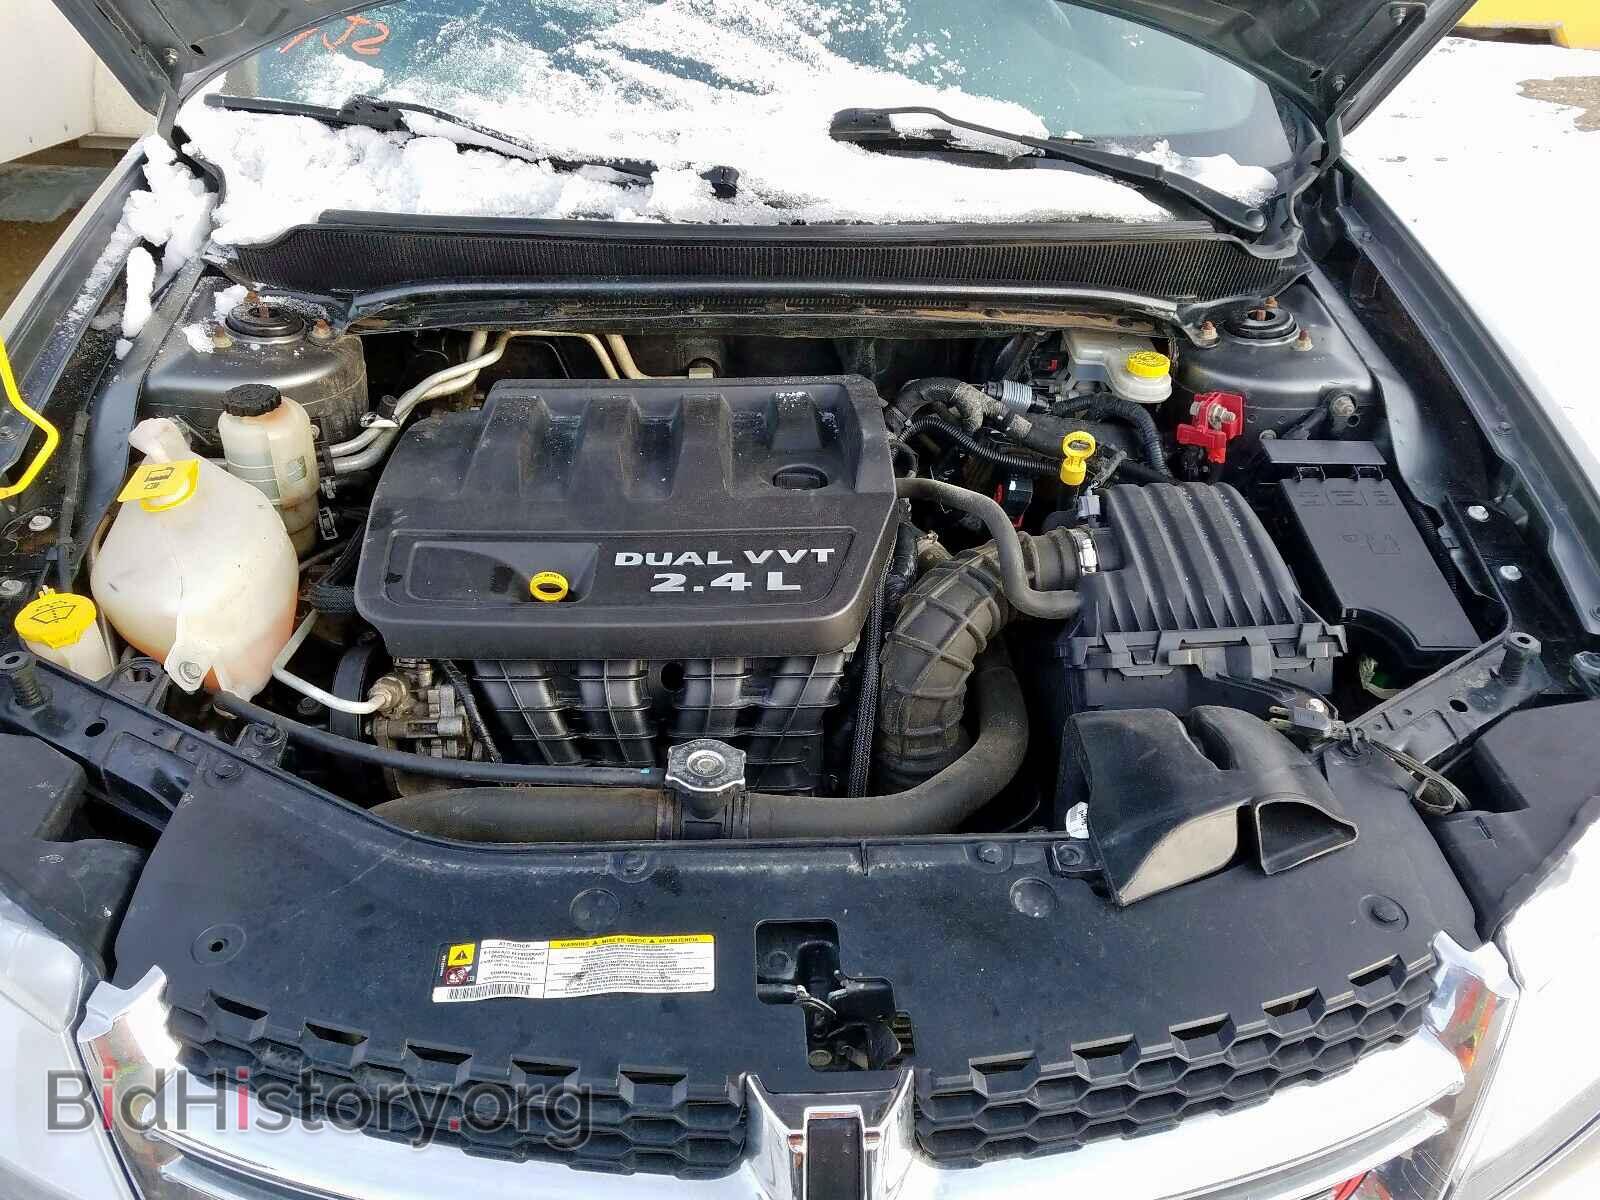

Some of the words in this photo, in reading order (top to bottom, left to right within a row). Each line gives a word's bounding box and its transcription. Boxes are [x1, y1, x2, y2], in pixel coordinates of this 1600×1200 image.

[614, 550, 733, 567] DUAL
[743, 548, 835, 565] VVT
[650, 572, 752, 593] 2.4
[766, 571, 802, 592] L
